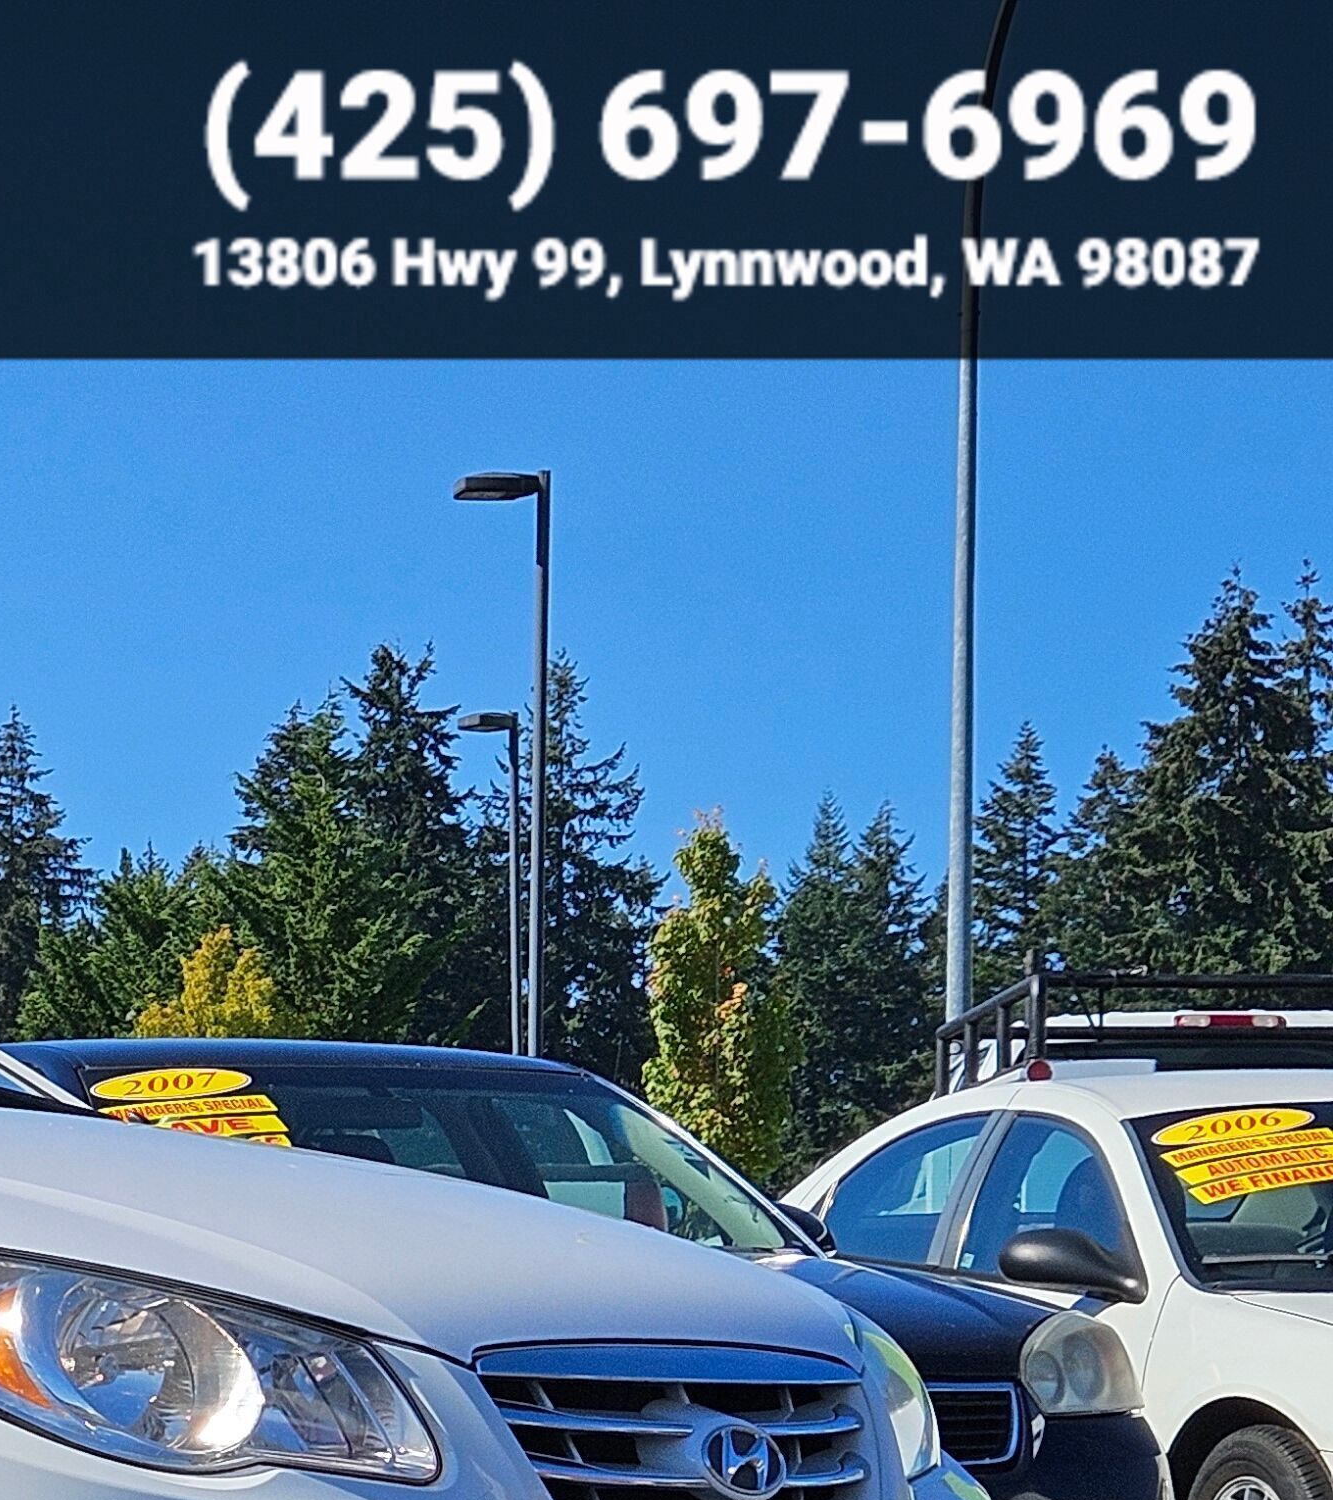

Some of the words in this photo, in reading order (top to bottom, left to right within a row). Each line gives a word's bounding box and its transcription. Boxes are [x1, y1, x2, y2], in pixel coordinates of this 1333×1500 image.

[123, 1071, 218, 1096] 2007
[205, 1097, 270, 1111] SPECIAL
[1184, 1111, 1282, 1141] 2006
[1171, 1136, 1264, 1163] MANAGER'S
[1266, 1131, 1329, 1146] SPECIAL
[1206, 1147, 1329, 1177] AUTOMATIC
[1201, 1179, 1244, 1198] WE
[1247, 1164, 1333, 1188] FINANC
